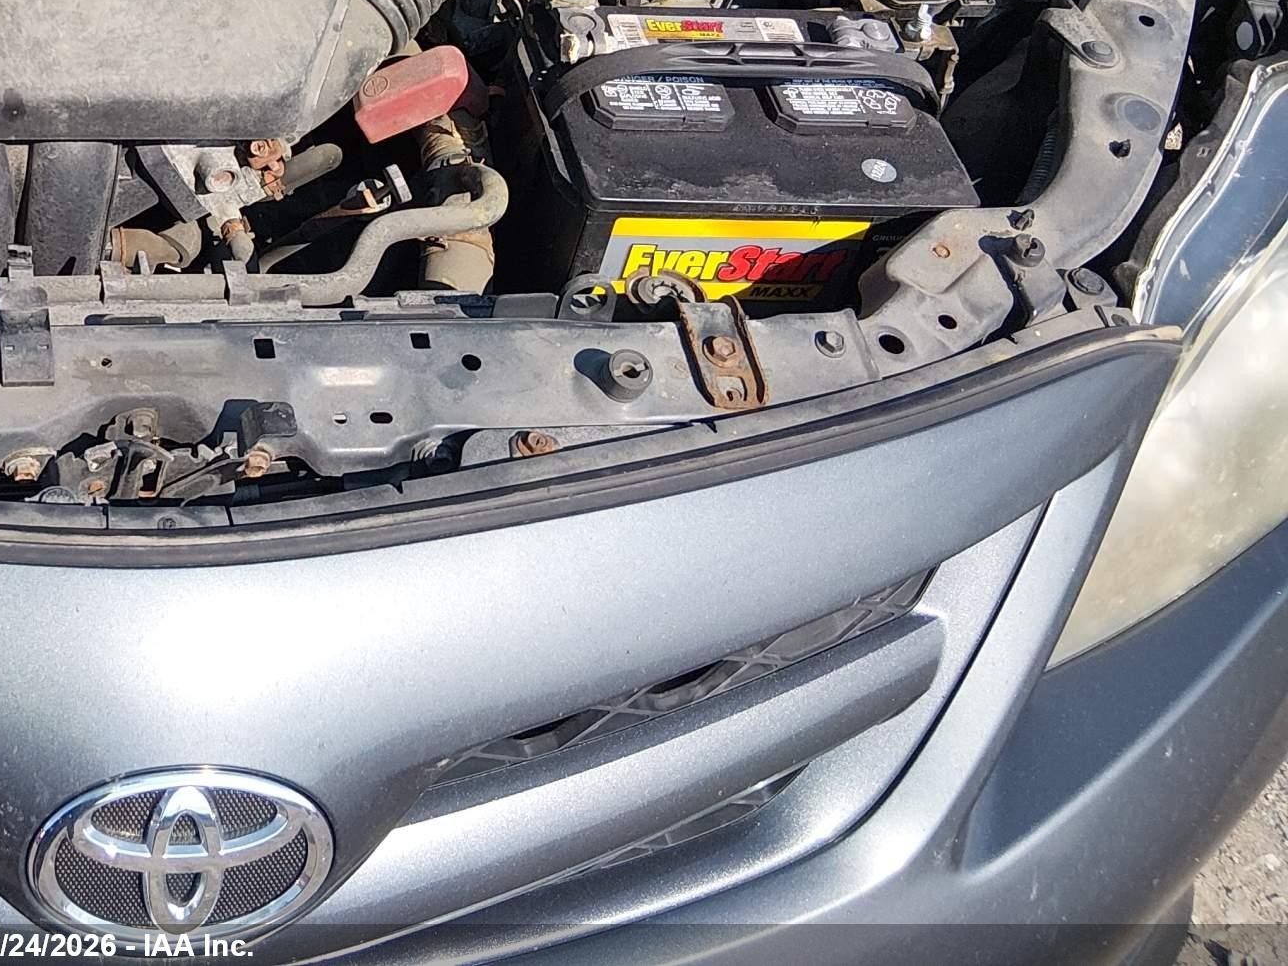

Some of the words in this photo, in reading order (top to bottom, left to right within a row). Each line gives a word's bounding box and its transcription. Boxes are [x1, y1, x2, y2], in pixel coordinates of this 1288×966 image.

[645, 19, 725, 32] EverStart
[622, 243, 848, 283] EverStart
[749, 286, 813, 298] MAXX
